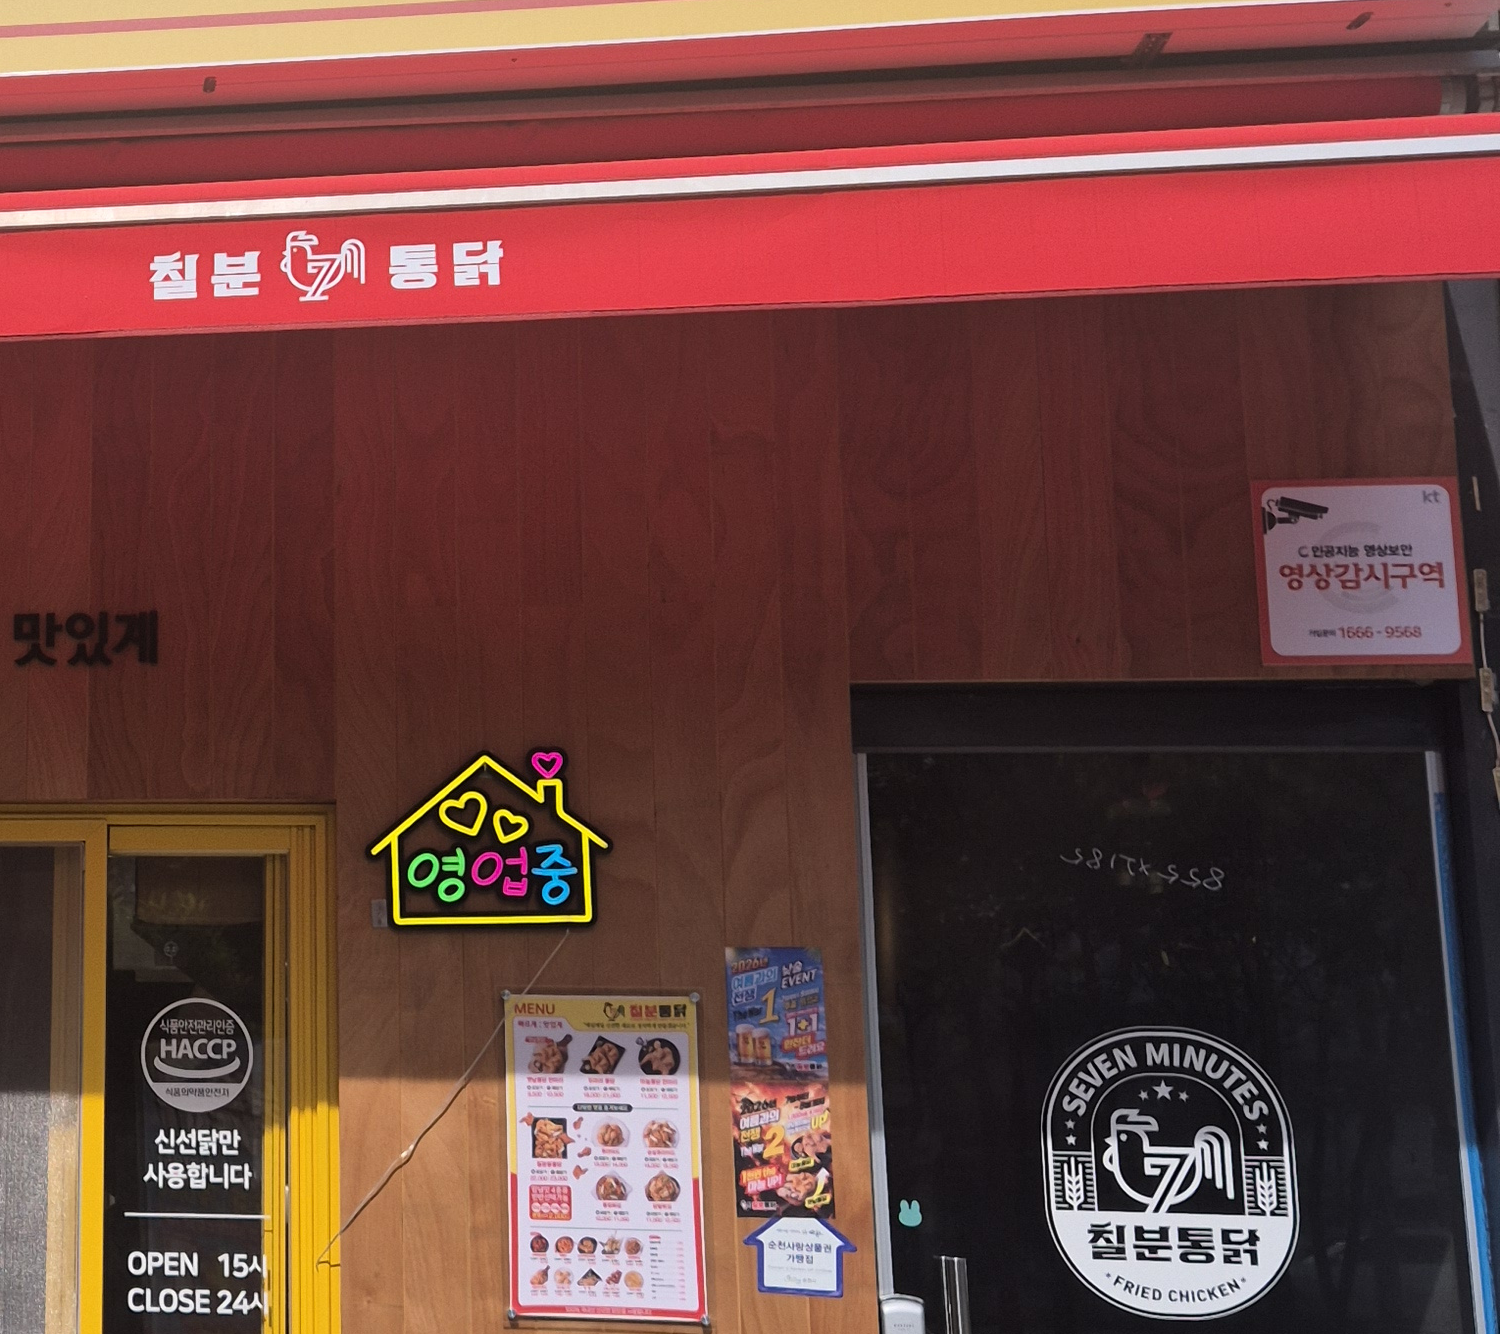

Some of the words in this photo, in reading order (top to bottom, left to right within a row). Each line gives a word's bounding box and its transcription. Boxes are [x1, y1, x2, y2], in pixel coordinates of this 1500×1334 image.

[150, 250, 262, 301] 칠분
[389, 240, 503, 290] 통닭
[1422, 490, 1441, 504] kt
[1311, 545, 1359, 557] 인공지능
[1364, 544, 1413, 557] 영상보안
[1279, 562, 1446, 591] 영상감시구역
[407, 844, 578, 905] 영업중
[781, 969, 817, 989] EVENT
[514, 1003, 556, 1015] MENU
[160, 1019, 235, 1035] 식품안전관리인증
[160, 1038, 237, 1059] HACCP
[1062, 1044, 1138, 1117] SEVEN
[1146, 1042, 1270, 1121] MINUTES
[154, 1128, 241, 1156] 신선닭만
[142, 1162, 252, 1190] 사용합니다
[768, 1240, 832, 1253] 순천사랑상품권
[1087, 1222, 1261, 1266] 칠분통닭
[127, 1250, 199, 1278] OPEN
[786, 1254, 814, 1264] 가맹점
[127, 1288, 211, 1314] CLOSE
[1113, 1274, 1163, 1302] FRIED
[1168, 1278, 1241, 1303] CHICKEN
